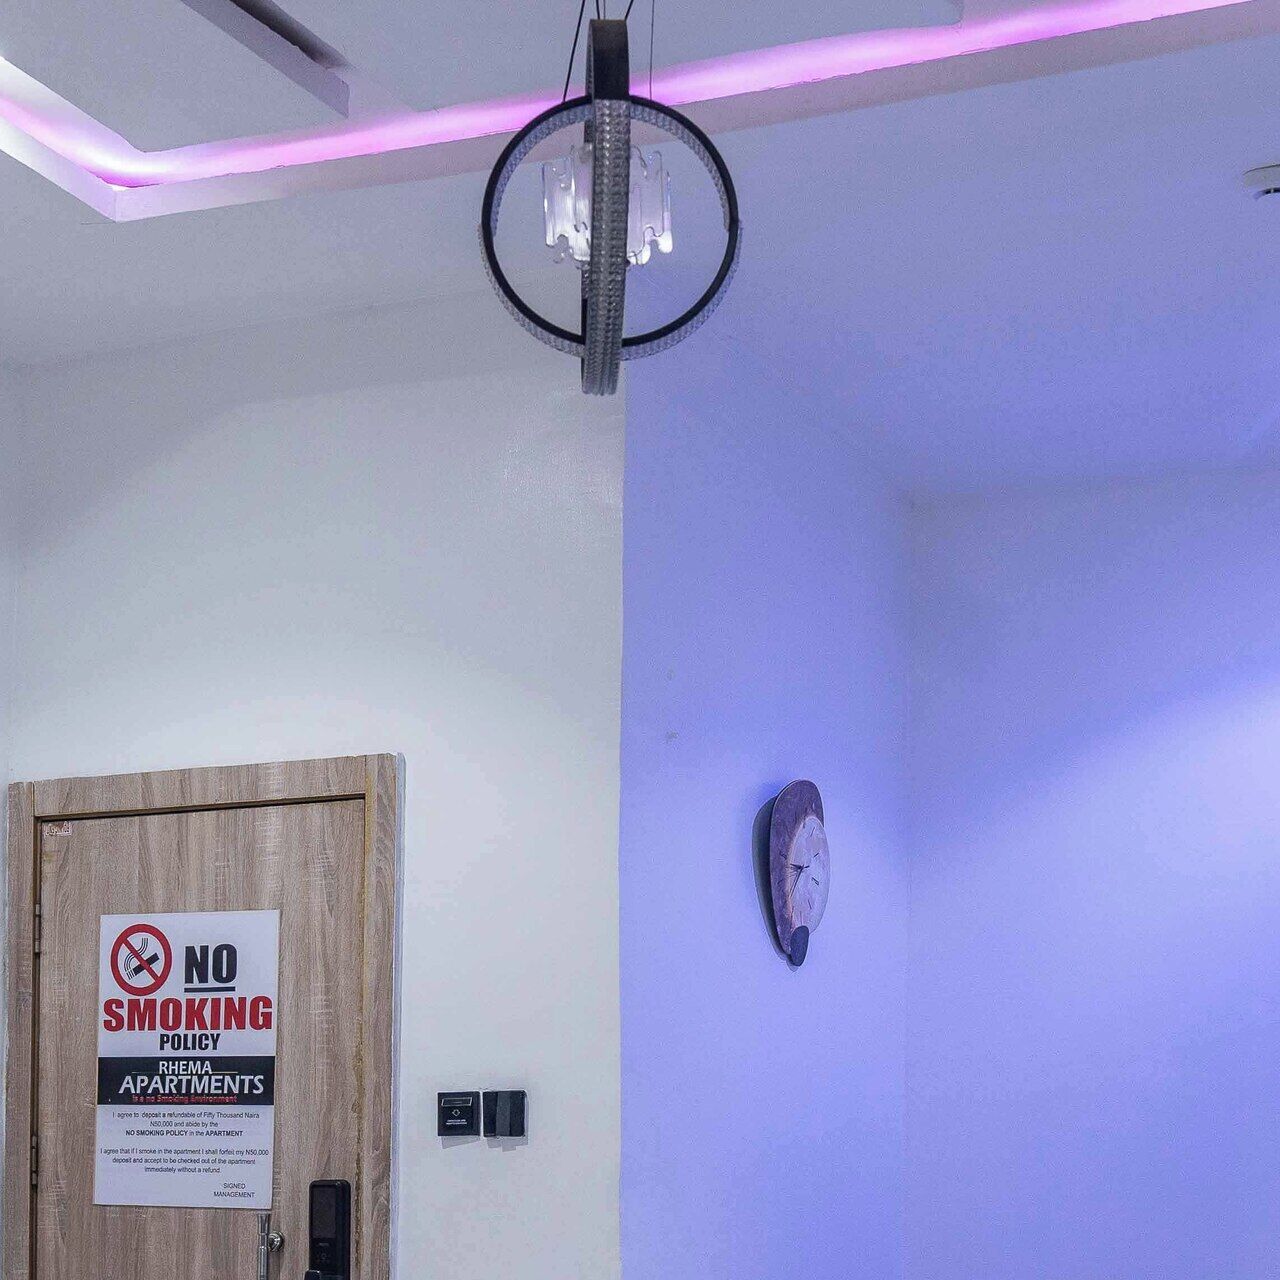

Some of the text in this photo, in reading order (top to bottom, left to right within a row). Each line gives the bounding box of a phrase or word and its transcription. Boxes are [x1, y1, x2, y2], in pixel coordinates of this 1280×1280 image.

[184, 943, 238, 984] NO
[103, 996, 272, 1032] SMOKING
[159, 1033, 221, 1051] POLICY
[158, 1061, 213, 1075] RHEMA
[118, 1075, 264, 1095] APARTMENTS
[157, 1094, 188, 1104] Smoking
[142, 1111, 161, 1119] deposit
[201, 1121, 208, 1129] by
[174, 1148, 201, 1156] apartment
